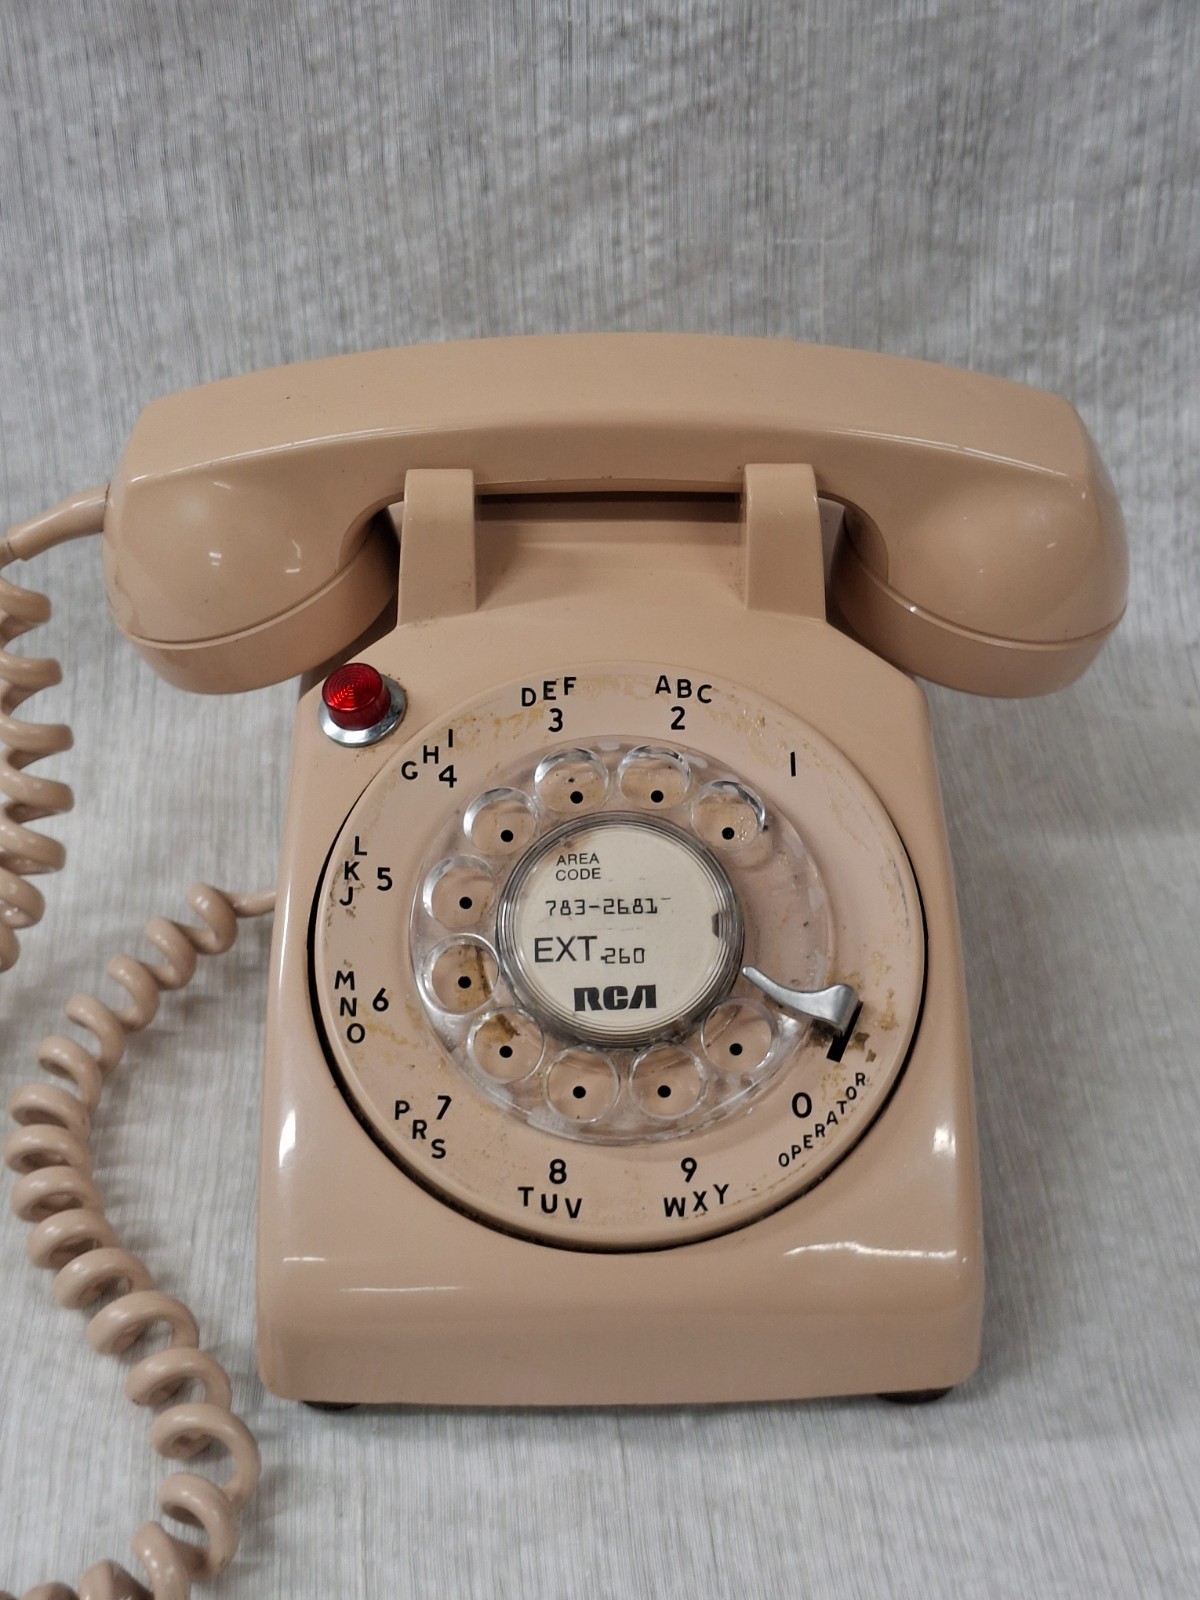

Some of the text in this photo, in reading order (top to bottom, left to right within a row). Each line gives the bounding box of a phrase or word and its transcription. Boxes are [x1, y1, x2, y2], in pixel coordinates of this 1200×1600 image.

[521, 676, 577, 708] DEF
[655, 675, 713, 704] ABC
[548, 707, 564, 733] 3
[670, 705, 686, 731] 2
[438, 764, 458, 789] 4
[556, 852, 600, 867] AREA
[376, 866, 393, 892] 5
[555, 867, 601, 882] CODE
[545, 897, 658, 916] 783-2681
[372, 987, 390, 1012] 6
[574, 984, 657, 1012] RCA
[436, 1094, 452, 1121] 7
[778, 1072, 866, 1167] OPERATOR
[548, 1158, 567, 1185] 8
[680, 1157, 698, 1183] 9
[517, 1186, 583, 1219] TUV
[663, 1183, 729, 1218] WXY
